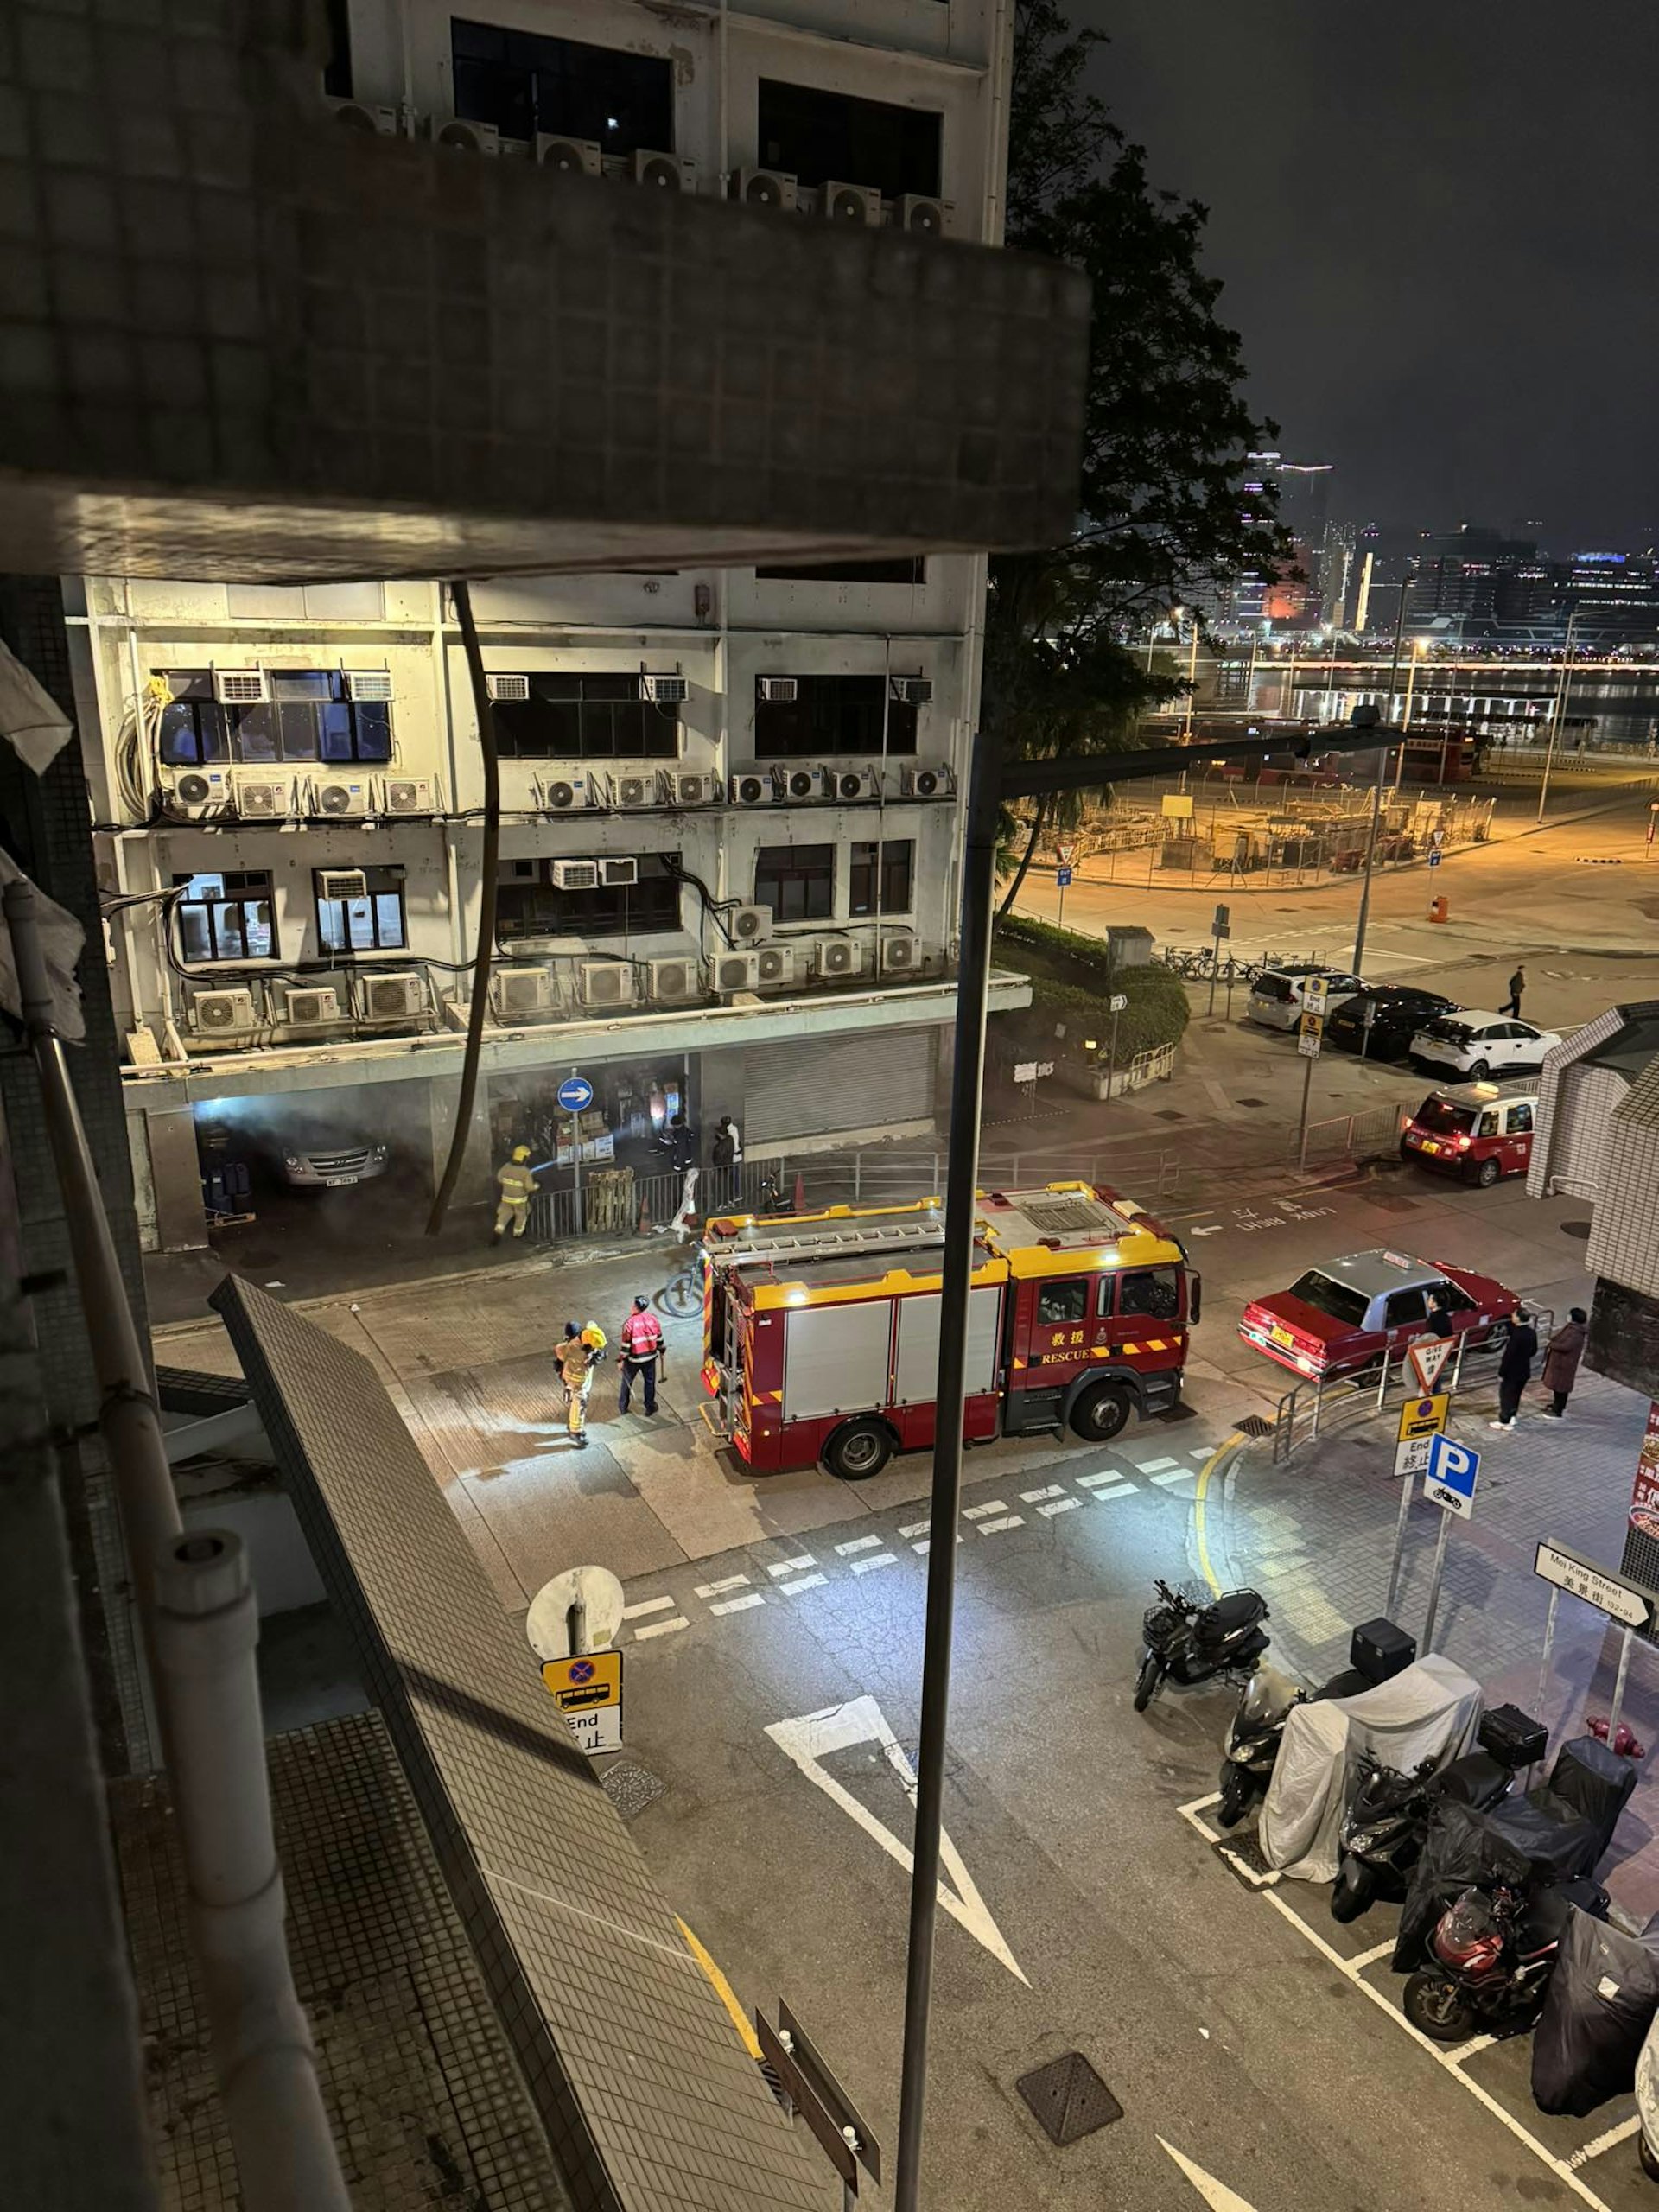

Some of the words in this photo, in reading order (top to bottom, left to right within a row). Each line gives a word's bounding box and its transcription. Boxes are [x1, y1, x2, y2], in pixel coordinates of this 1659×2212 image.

[1235, 1217, 1287, 1231] RIGHT
[1051, 1329, 1084, 1347] 救援
[1041, 1349, 1090, 1364] RESCUE
[1426, 1345, 1442, 1355] GIVE
[1426, 1354, 1440, 1363] WAY
[1410, 1439, 1430, 1452] End
[1436, 1440, 1470, 1480] P
[1550, 1554, 1567, 1569] Mei
[1567, 1563, 1590, 1581] King
[1591, 1575, 1623, 1599] Street
[1563, 1575, 1605, 1605] 美景街
[567, 1713, 598, 1731] End
